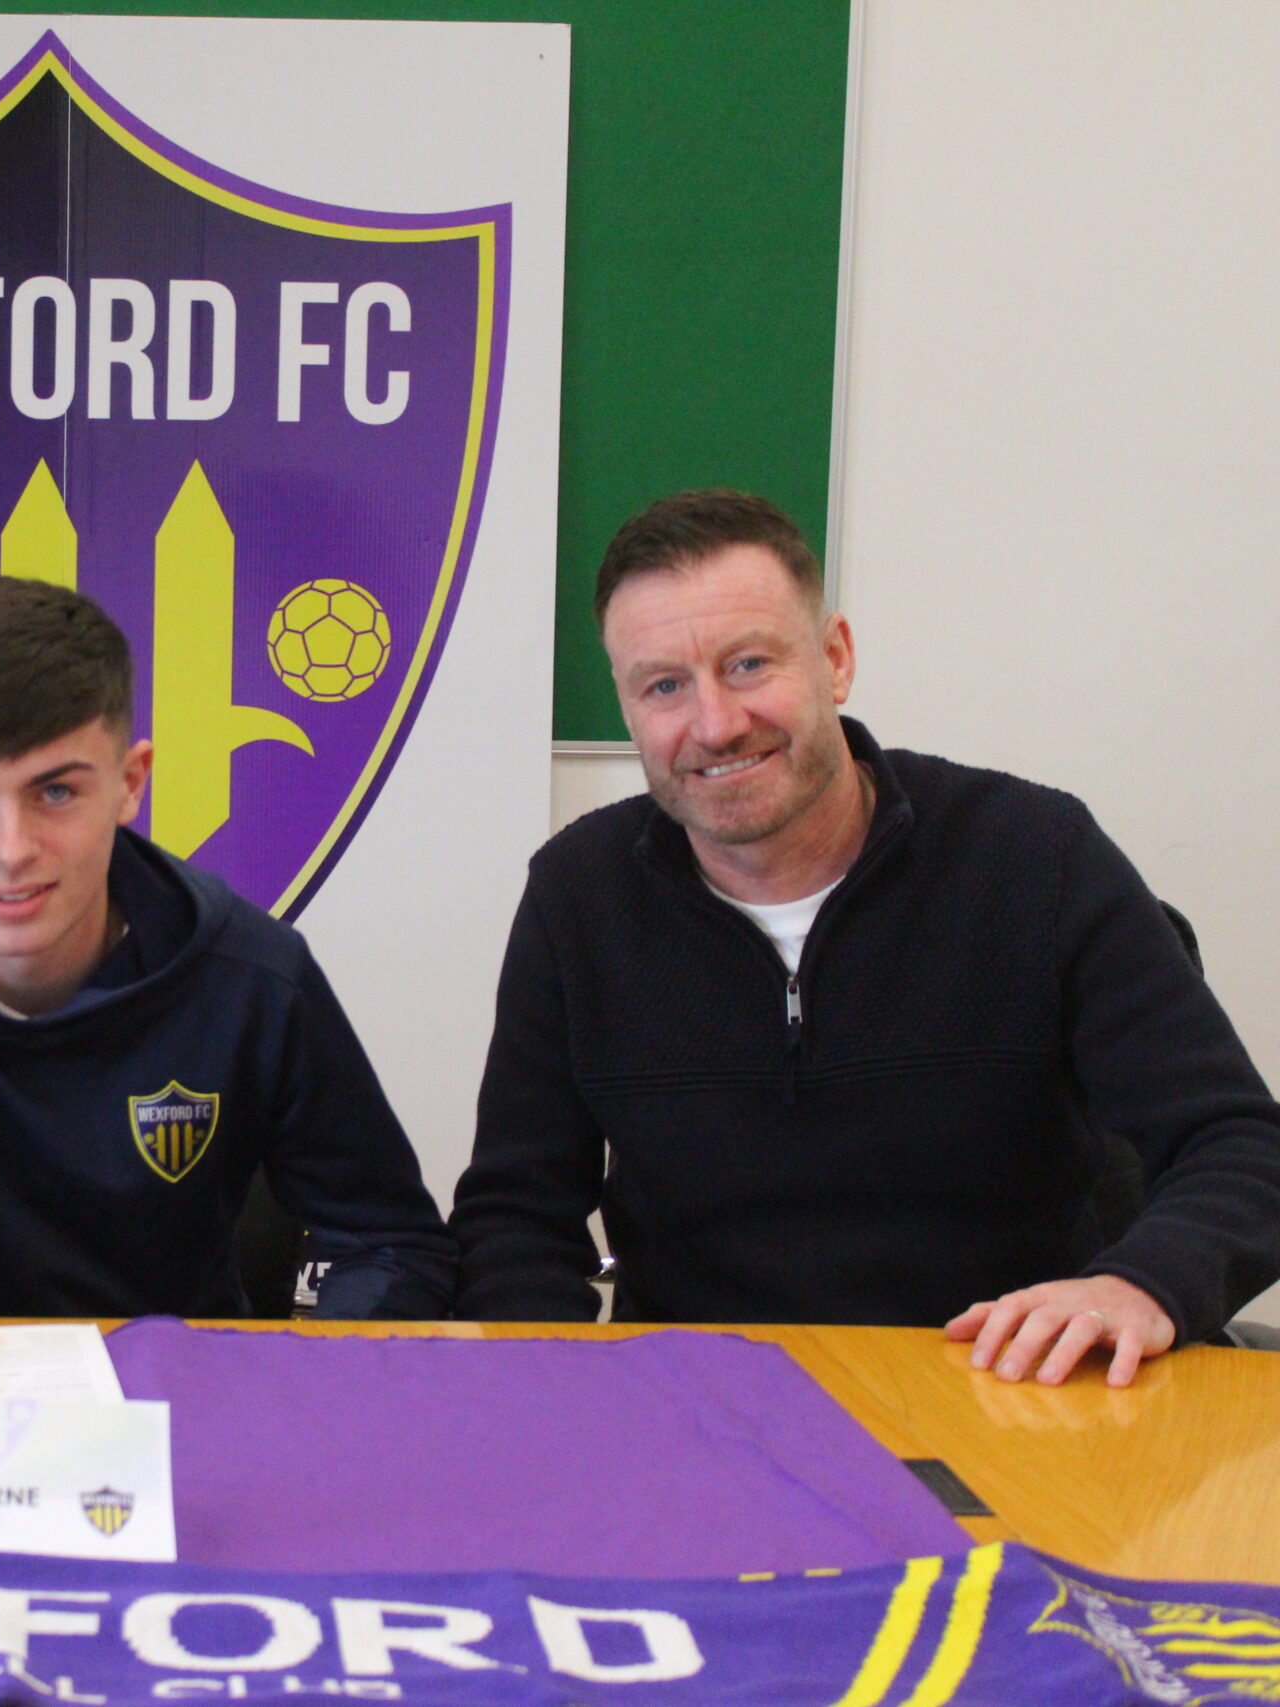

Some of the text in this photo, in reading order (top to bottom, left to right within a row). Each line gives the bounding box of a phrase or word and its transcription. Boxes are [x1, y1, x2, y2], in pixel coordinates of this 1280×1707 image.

[277, 280, 412, 426] FC
[137, 1103, 211, 1123] WEXFORD FC
